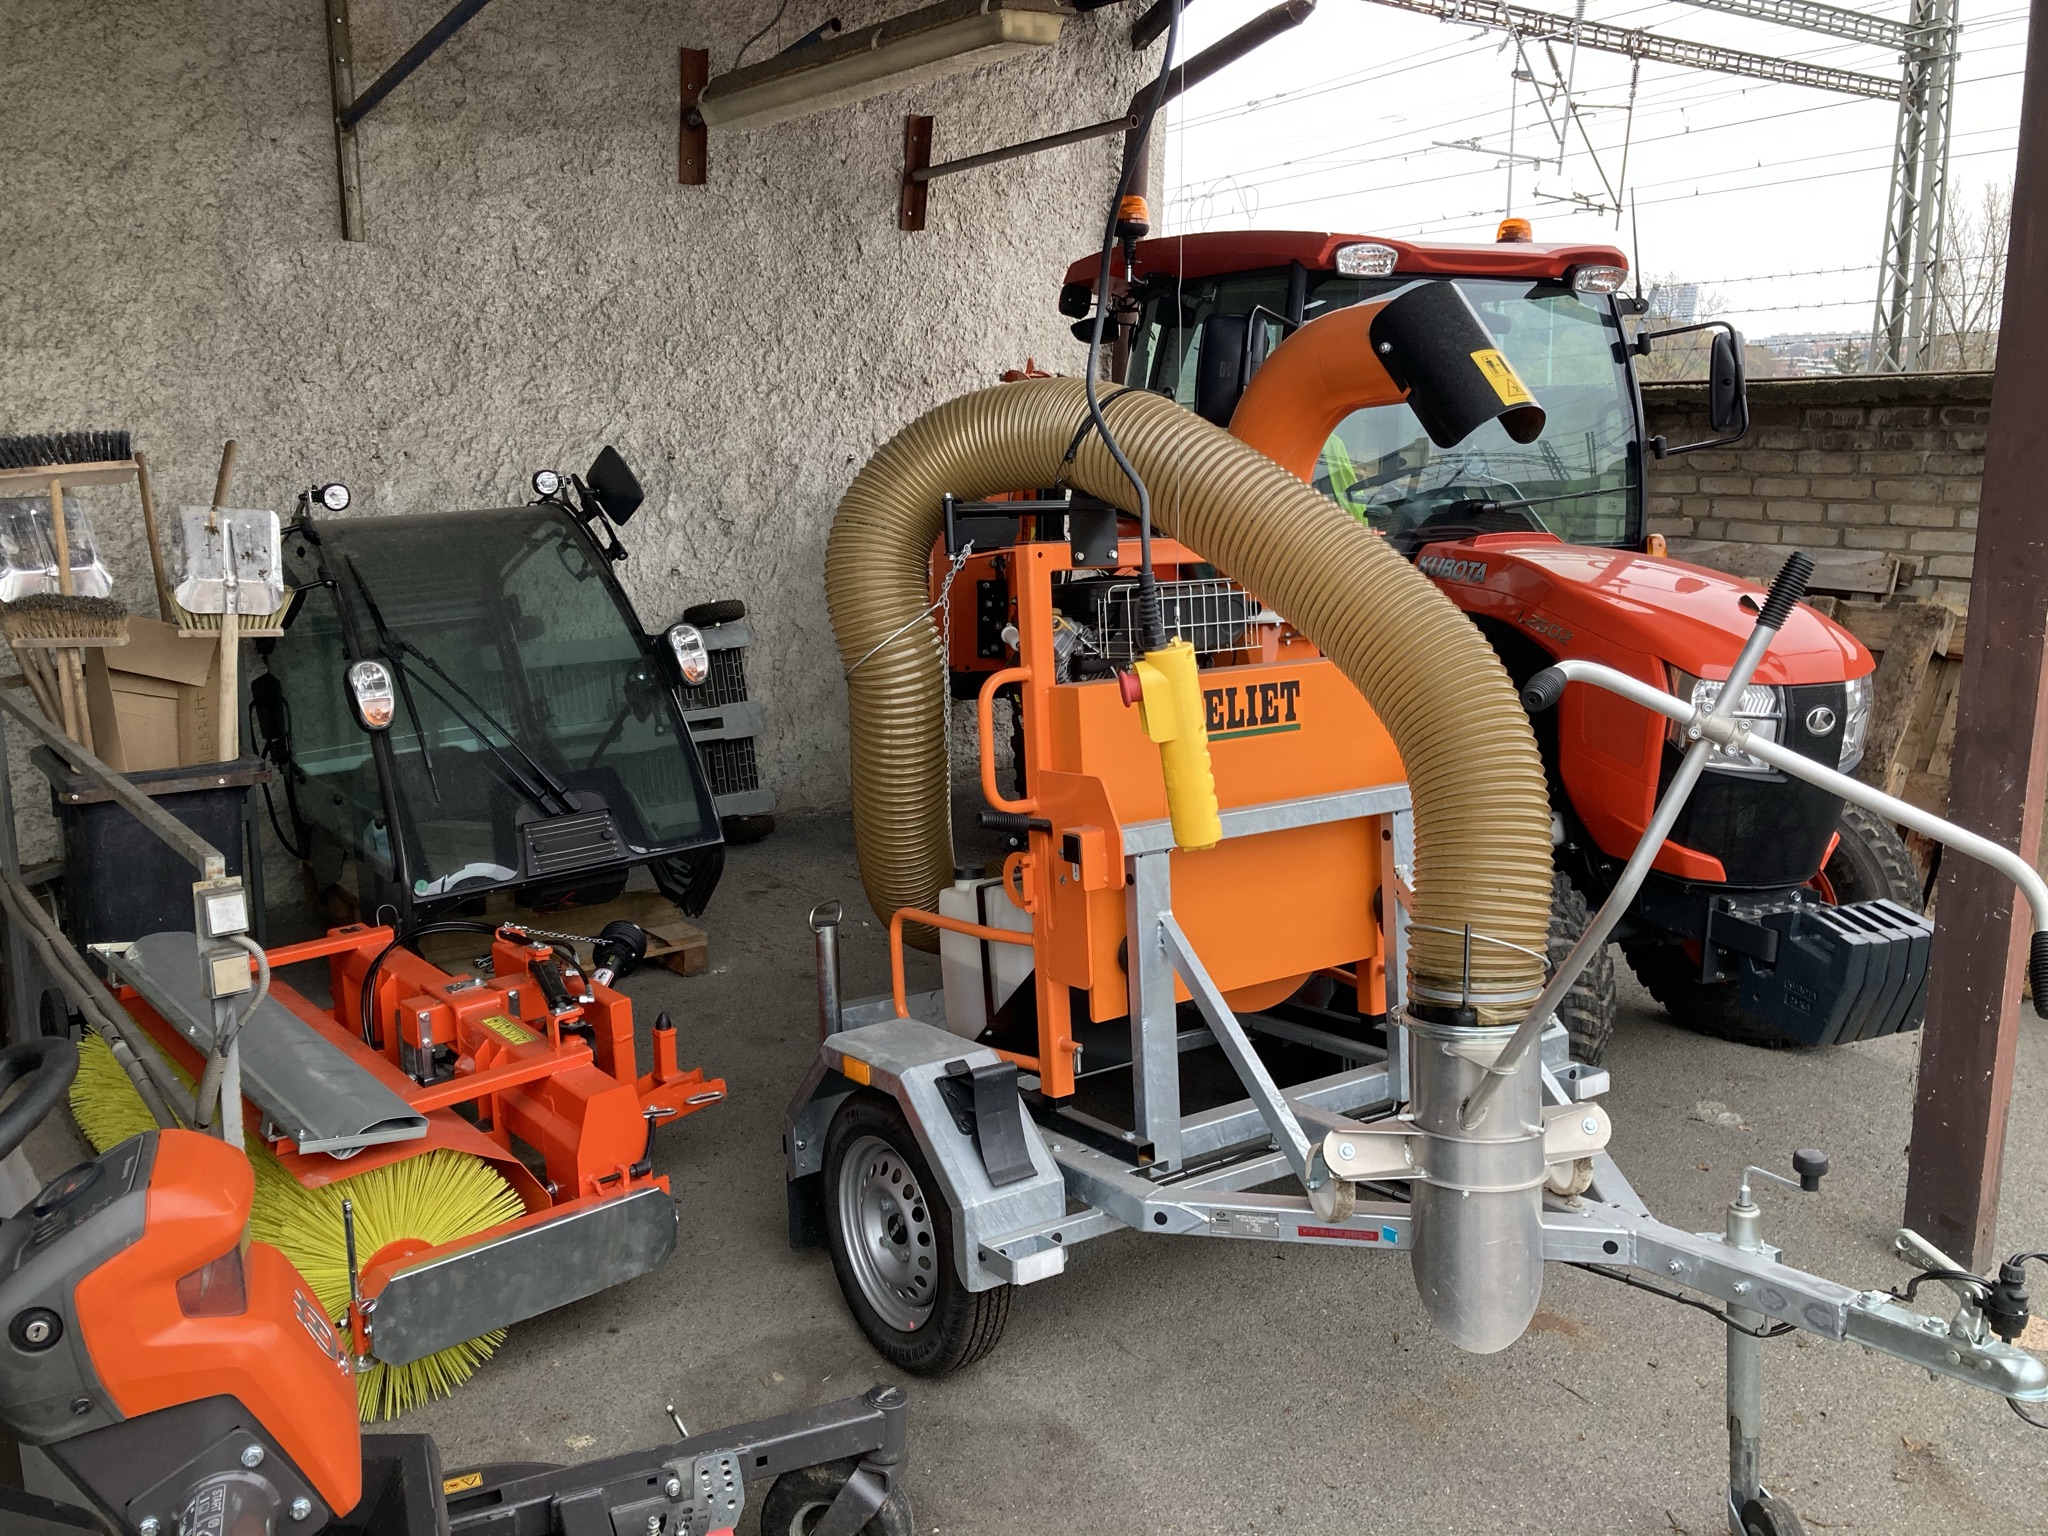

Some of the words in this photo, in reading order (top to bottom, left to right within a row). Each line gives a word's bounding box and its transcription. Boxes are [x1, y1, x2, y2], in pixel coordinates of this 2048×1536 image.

[1418, 555, 1487, 584] KUBOTA
[1203, 680, 1300, 732] ELIET
[211, 1489, 224, 1512] START
